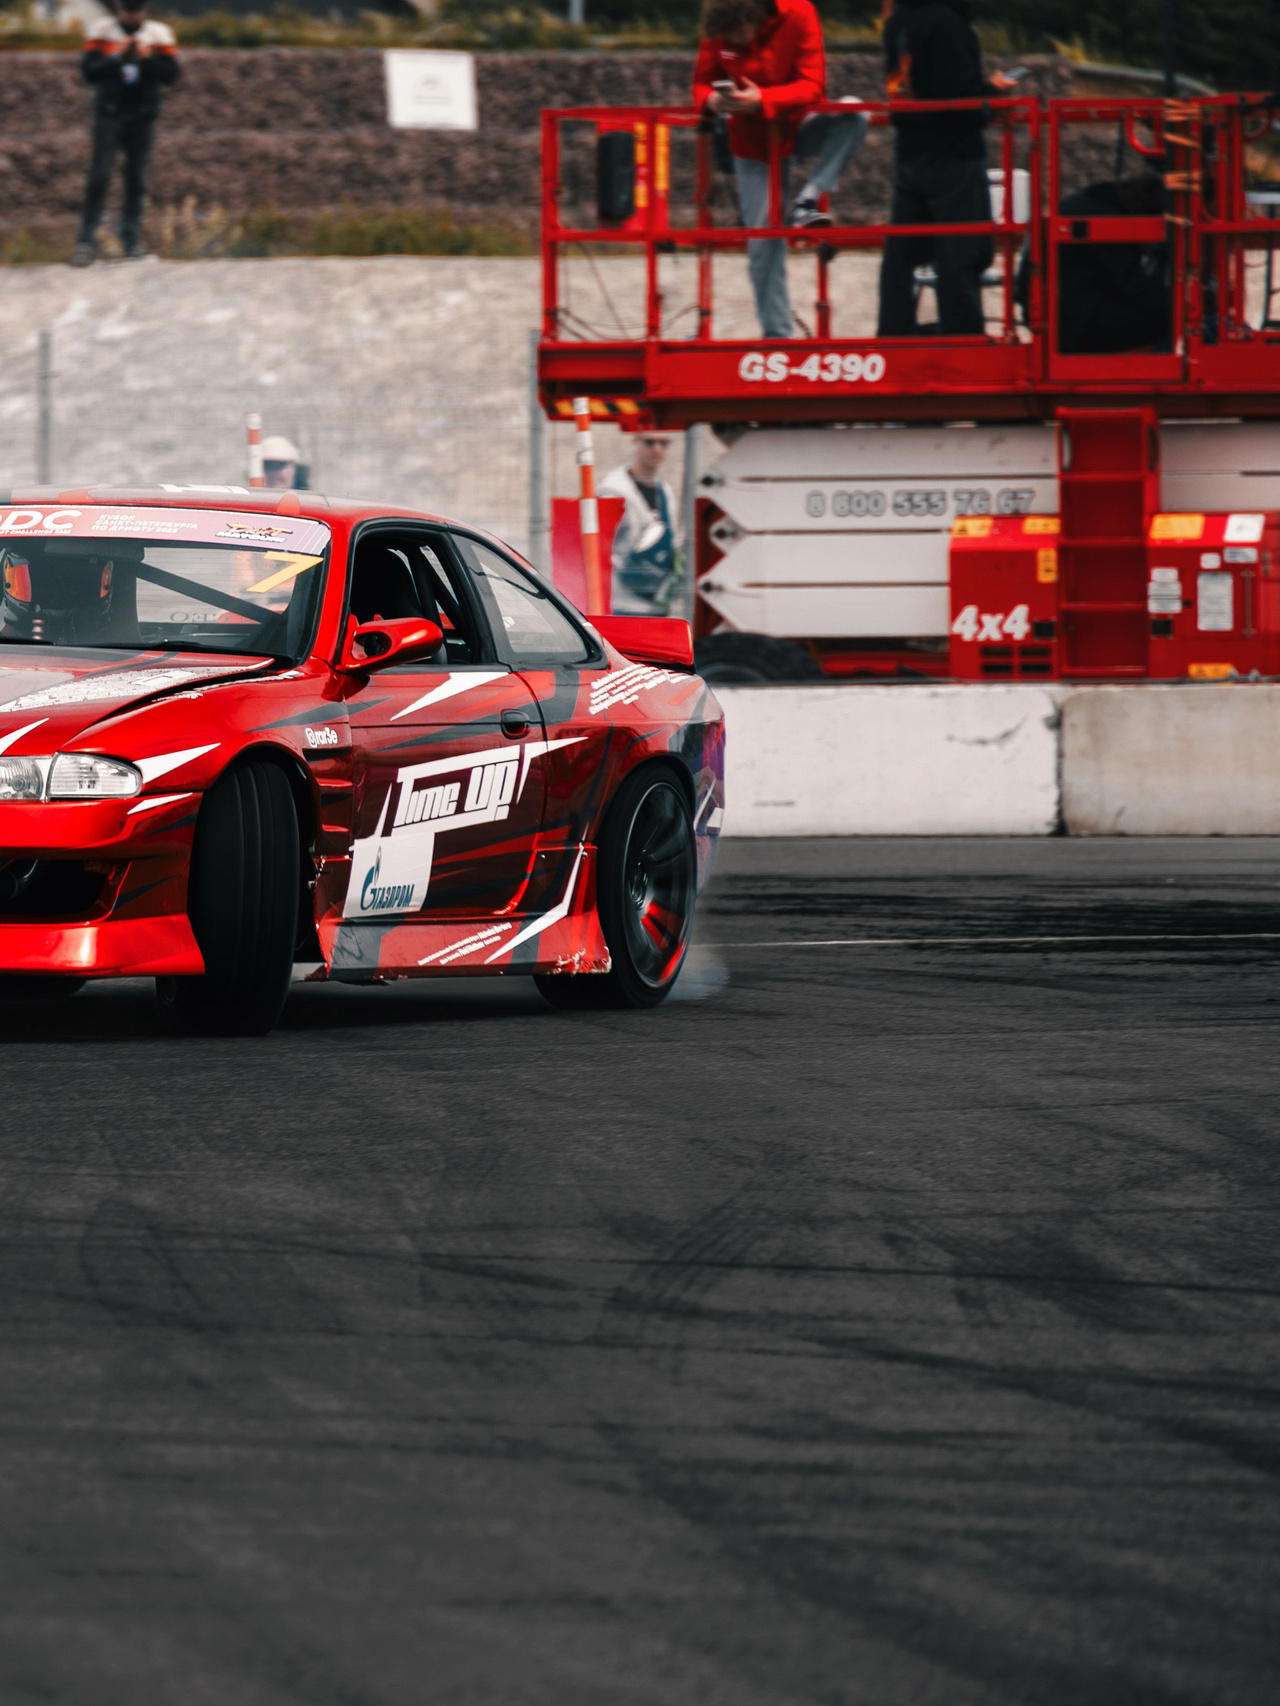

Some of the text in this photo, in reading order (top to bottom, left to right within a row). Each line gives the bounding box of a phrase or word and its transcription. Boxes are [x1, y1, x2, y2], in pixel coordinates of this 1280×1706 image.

[740, 352, 886, 382] GS-4390
[806, 490, 826, 517] 8
[832, 490, 888, 517] 800
[892, 489, 947, 516] 555
[246, 551, 324, 593] 7
[951, 604, 1030, 641] 4x4
[372, 884, 415, 911] ГАЗПРОМ
